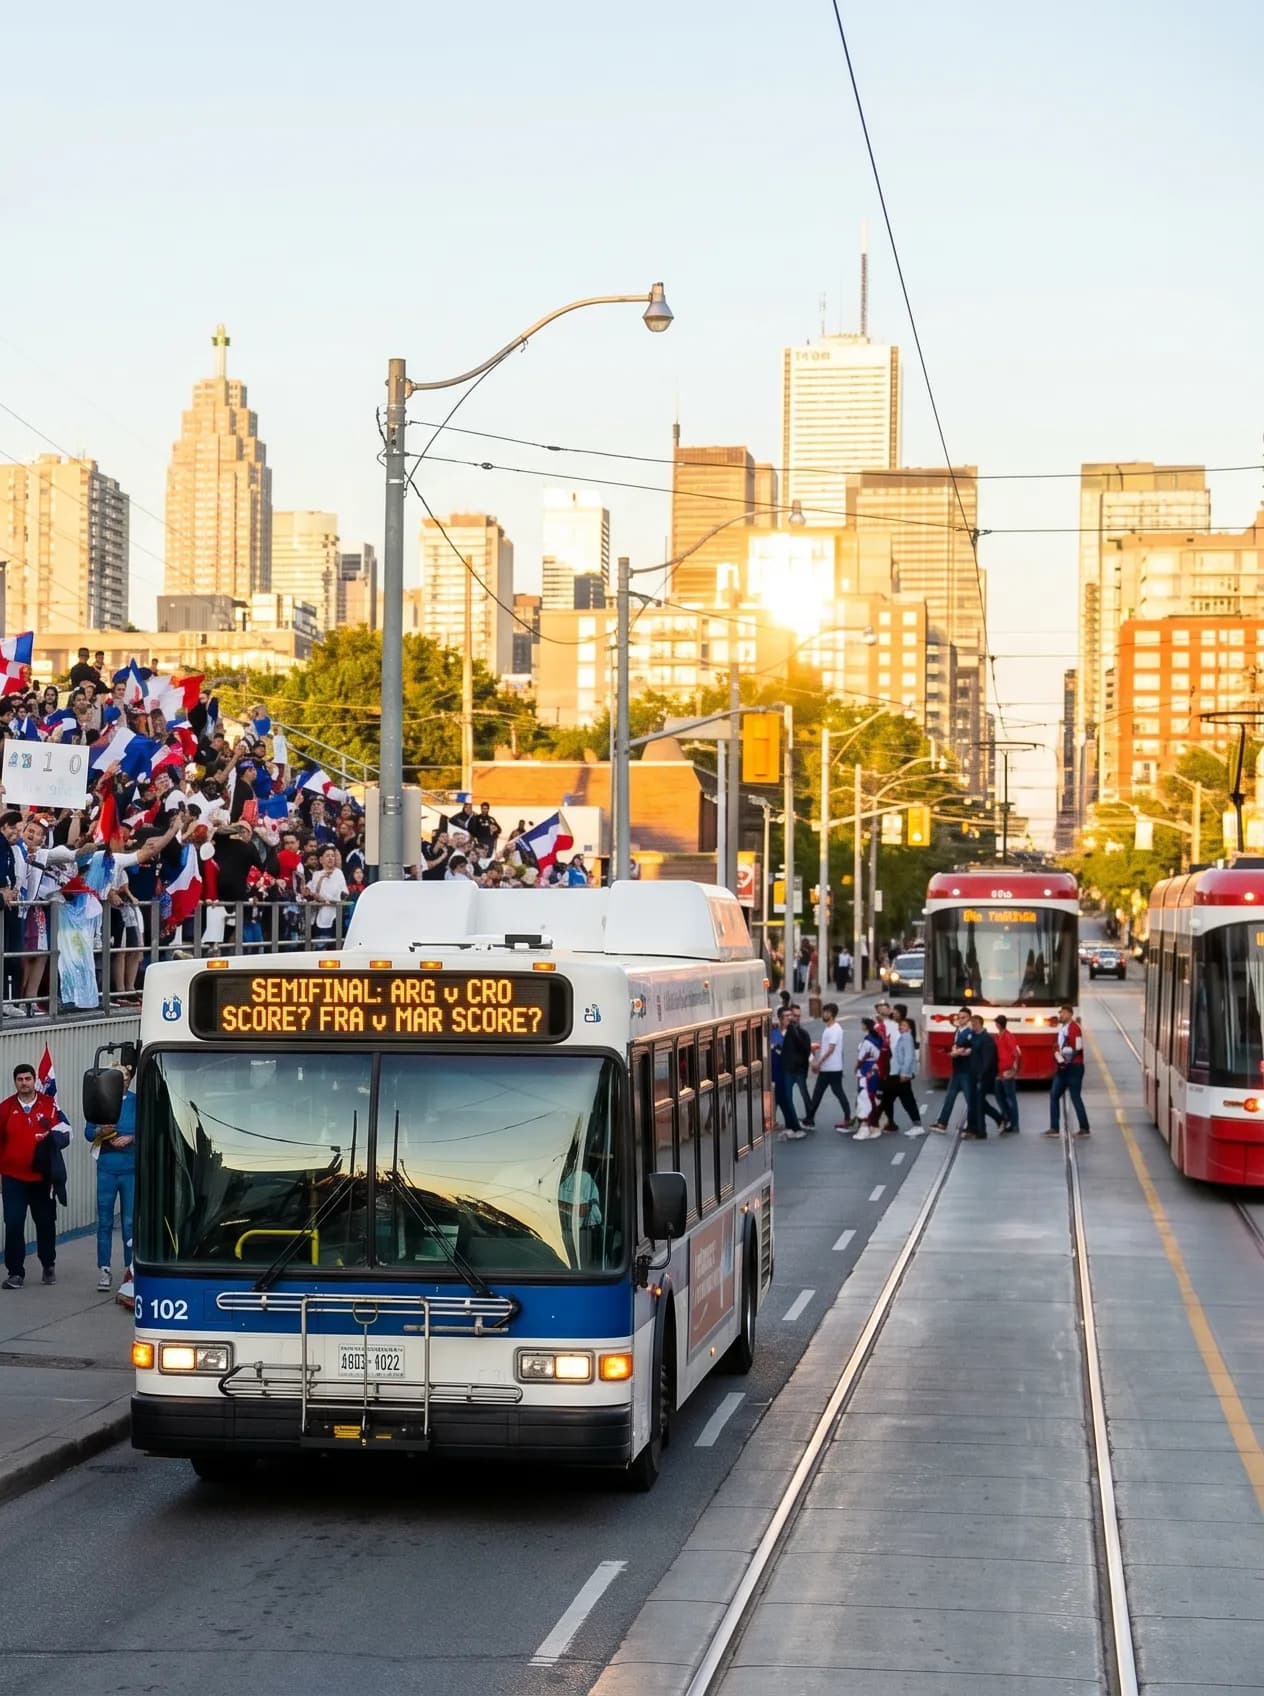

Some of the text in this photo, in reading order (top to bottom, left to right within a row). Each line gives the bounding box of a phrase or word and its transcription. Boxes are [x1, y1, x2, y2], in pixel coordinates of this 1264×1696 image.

[251, 978, 382, 1004] SEMIFINAL:
[391, 979, 435, 1004] ARG
[467, 979, 512, 1005] CRO
[223, 1005, 311, 1032] SCORE?
[319, 1006, 363, 1032] FRA
[395, 1007, 443, 1033] MAR
[451, 1007, 542, 1033] SCORE?
[150, 1299, 189, 1320] 102
